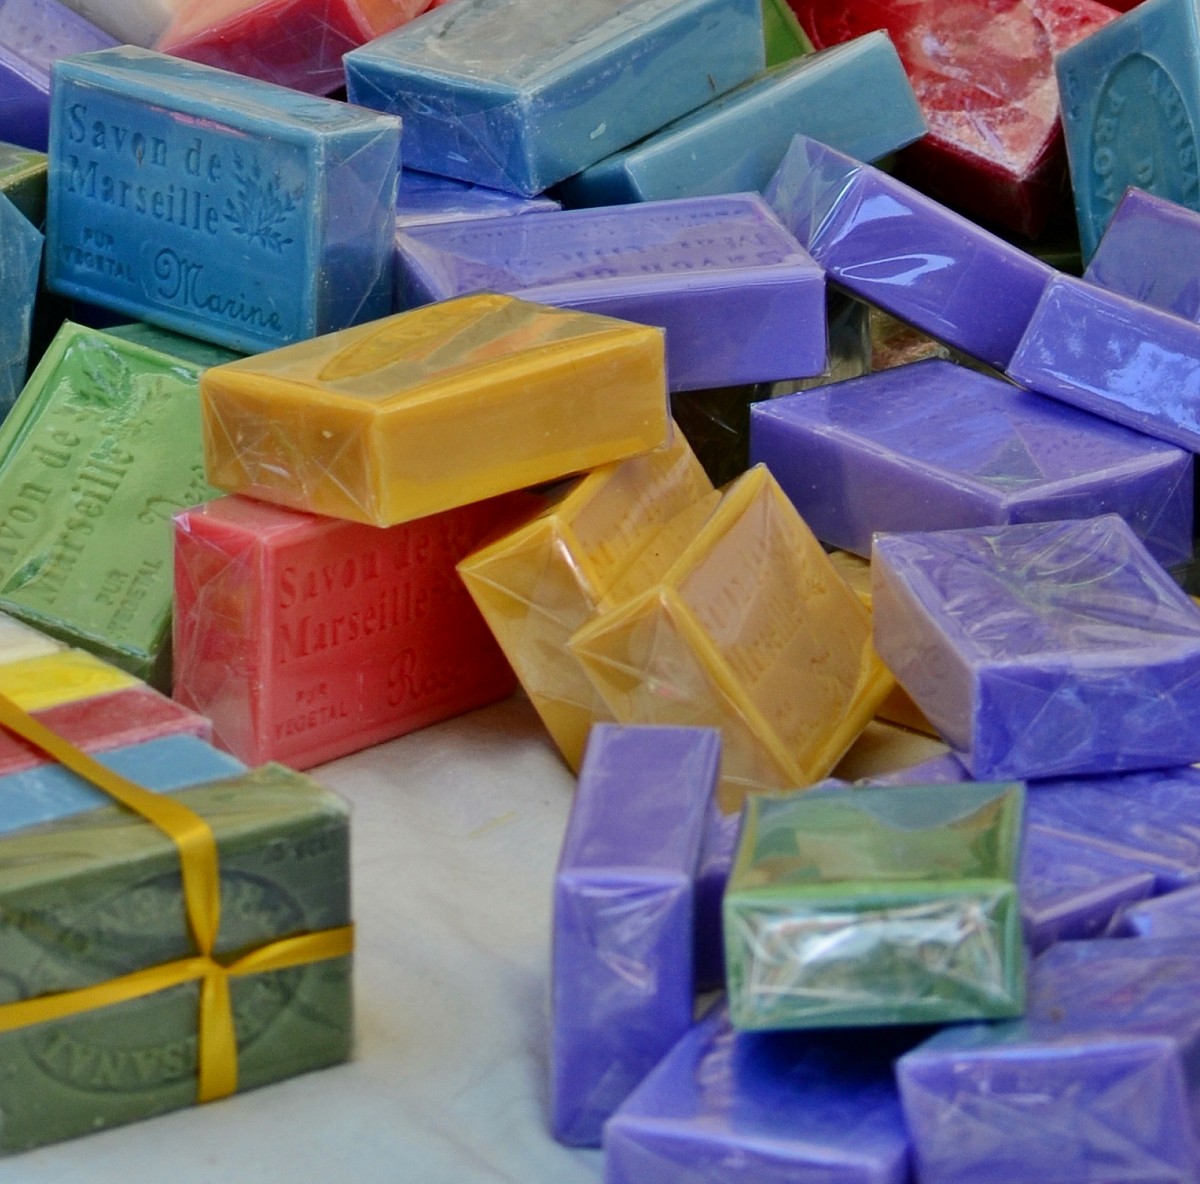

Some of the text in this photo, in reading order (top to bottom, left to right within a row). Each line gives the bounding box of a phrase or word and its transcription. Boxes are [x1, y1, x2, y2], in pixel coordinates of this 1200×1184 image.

[67, 102, 223, 183] Savon de
[65, 154, 220, 237] Marseille
[153, 247, 284, 333] Marine
[31, 428, 81, 469] de
[278, 528, 432, 611] Savon de
[278, 580, 432, 664] Marseille
